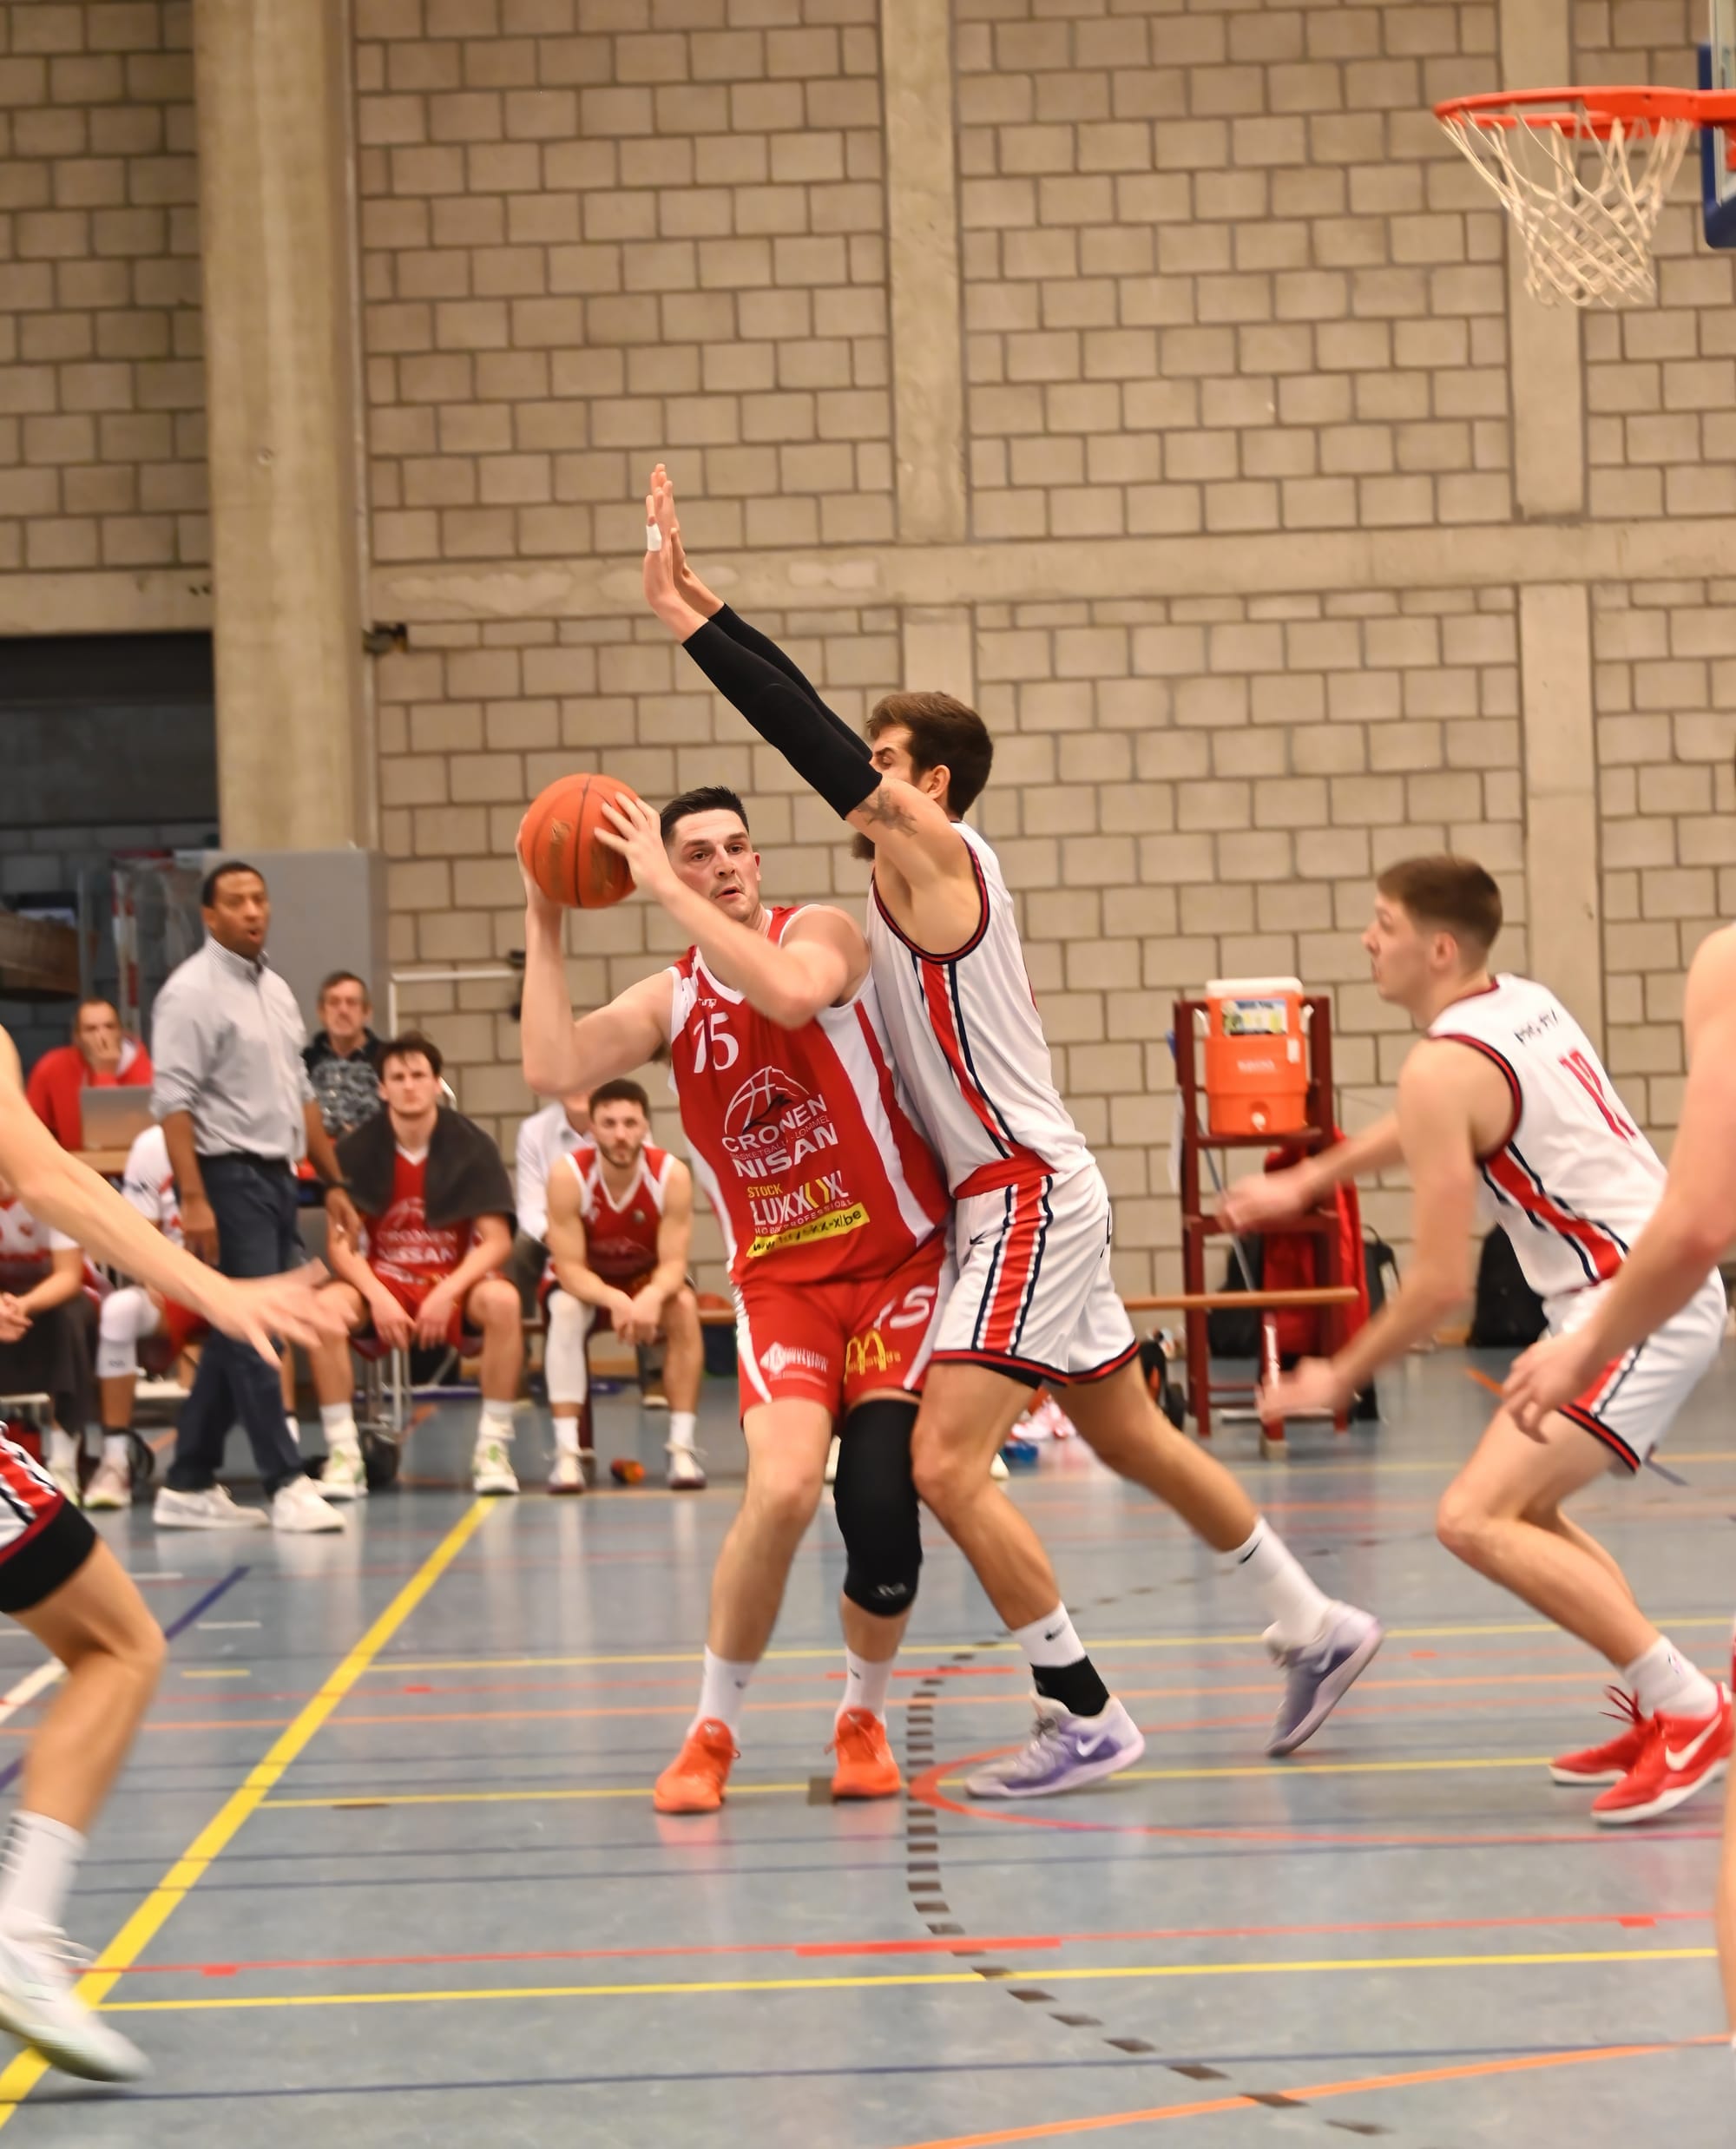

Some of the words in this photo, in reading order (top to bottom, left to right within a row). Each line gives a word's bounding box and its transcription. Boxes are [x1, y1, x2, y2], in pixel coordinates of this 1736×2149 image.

[694, 1011, 740, 1074] 15
[721, 1094, 827, 1153] CRONEN
[746, 1183, 783, 1199] STOCK
